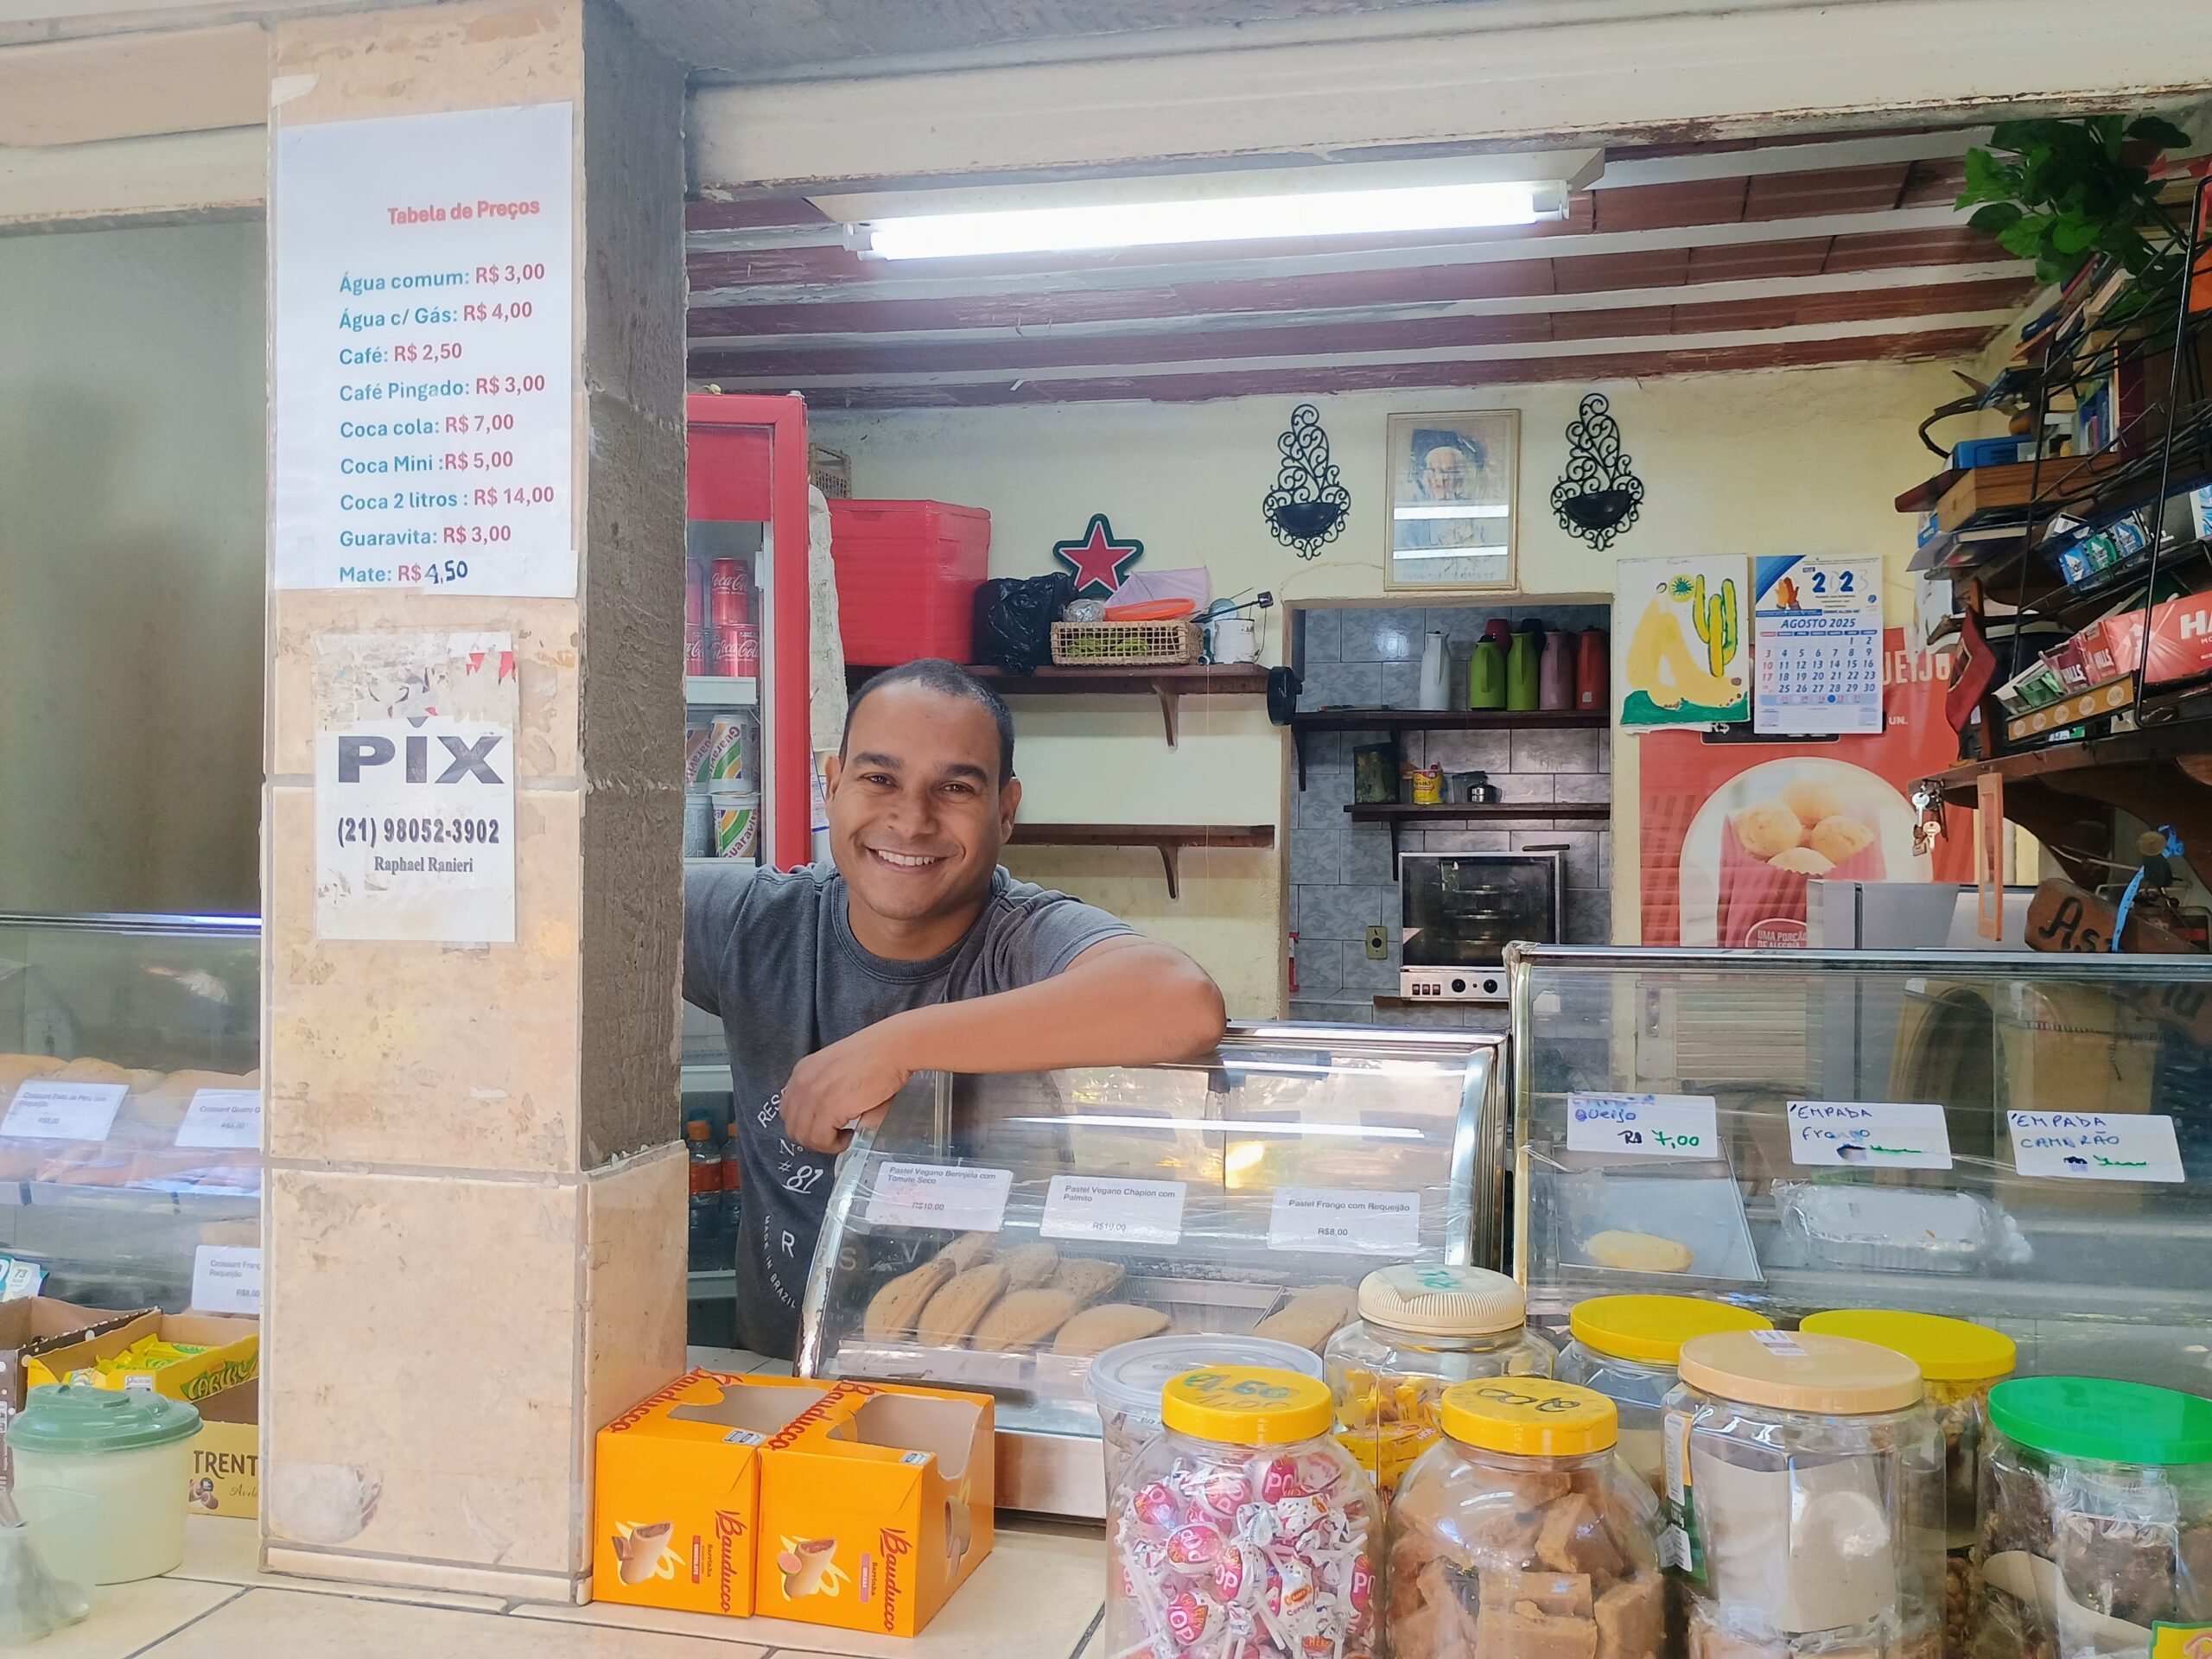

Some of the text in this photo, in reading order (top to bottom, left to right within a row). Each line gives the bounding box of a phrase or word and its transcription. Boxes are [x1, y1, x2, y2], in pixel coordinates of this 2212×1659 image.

[387, 199, 540, 225] Tabela de Preços
[340, 264, 545, 296] Água comum: R$ 3,00
[340, 302, 532, 333] Água c/ Gás: R$ 4,00
[340, 343, 462, 366] Café: R$ 2,50
[340, 375, 545, 403] Café Pingado: R$ 3,00
[340, 414, 514, 439] Coca cola: R$ 7,00
[340, 457, 388, 476] Coca
[393, 454, 433, 473] Mini
[473, 450, 513, 471] 5,00
[340, 493, 388, 512] Coca
[393, 491, 404, 510] 2
[409, 490, 458, 510] litros
[474, 489, 498, 508] R$
[503, 486, 555, 506] 14,00
[340, 524, 512, 548] Guaravita: R$ 3,00
[340, 563, 392, 584] Mate:
[397, 563, 423, 583] R$
[1781, 618, 1857, 628] AGOSTO 2025
[1866, 636, 1872, 645] 2
[1763, 661, 1773, 670] 10
[1780, 661, 1789, 670] 11
[1796, 661, 1807, 670] 12
[1813, 660, 1823, 669] 13
[1847, 659, 1858, 668] 15
[1864, 659, 1874, 668] 16
[1765, 649, 1771, 658] 3
[1848, 648, 1854, 657] 8
[1763, 673, 1772, 682] 17
[1796, 672, 1807, 681] 19
[1830, 671, 1841, 680] 21
[1847, 671, 1859, 680] 22
[1864, 671, 1875, 679] 23
[1883, 649, 1951, 686] UEIJO
[1778, 684, 1790, 693] 25
[1796, 684, 1808, 693] 26
[1829, 683, 1840, 692] 28
[1847, 683, 1858, 692] 29
[1888, 715, 1908, 725] UN.
[338, 817, 499, 848] (21) 98052-3902
[374, 856, 474, 875] Raphael Ranieri
[1758, 930, 1776, 941] UMA
[1651, 1129, 1700, 1149] 7,00
[889, 1166, 913, 1175] Pastel
[915, 1168, 944, 1178] Vegano
[944, 1170, 978, 1180] Berinjela
[1065, 1185, 1090, 1193] Pastel
[1091, 1186, 1122, 1196] Vegano
[1123, 1188, 1156, 1198] Chapion
[1288, 1198, 1315, 1208] Pastel
[1316, 1199, 1346, 1210] Frango
[1368, 1202, 1410, 1212] Requeijão
[781, 1230, 795, 1258] R
[766, 1255, 773, 1269] IN
[770, 1273, 796, 1309] BRAZIL
[766, 1380, 888, 1451] Bauducco
[194, 1450, 258, 1479] TRENT
[715, 1510, 747, 1613] Bauducco
[880, 1528, 912, 1632] Bauducco
